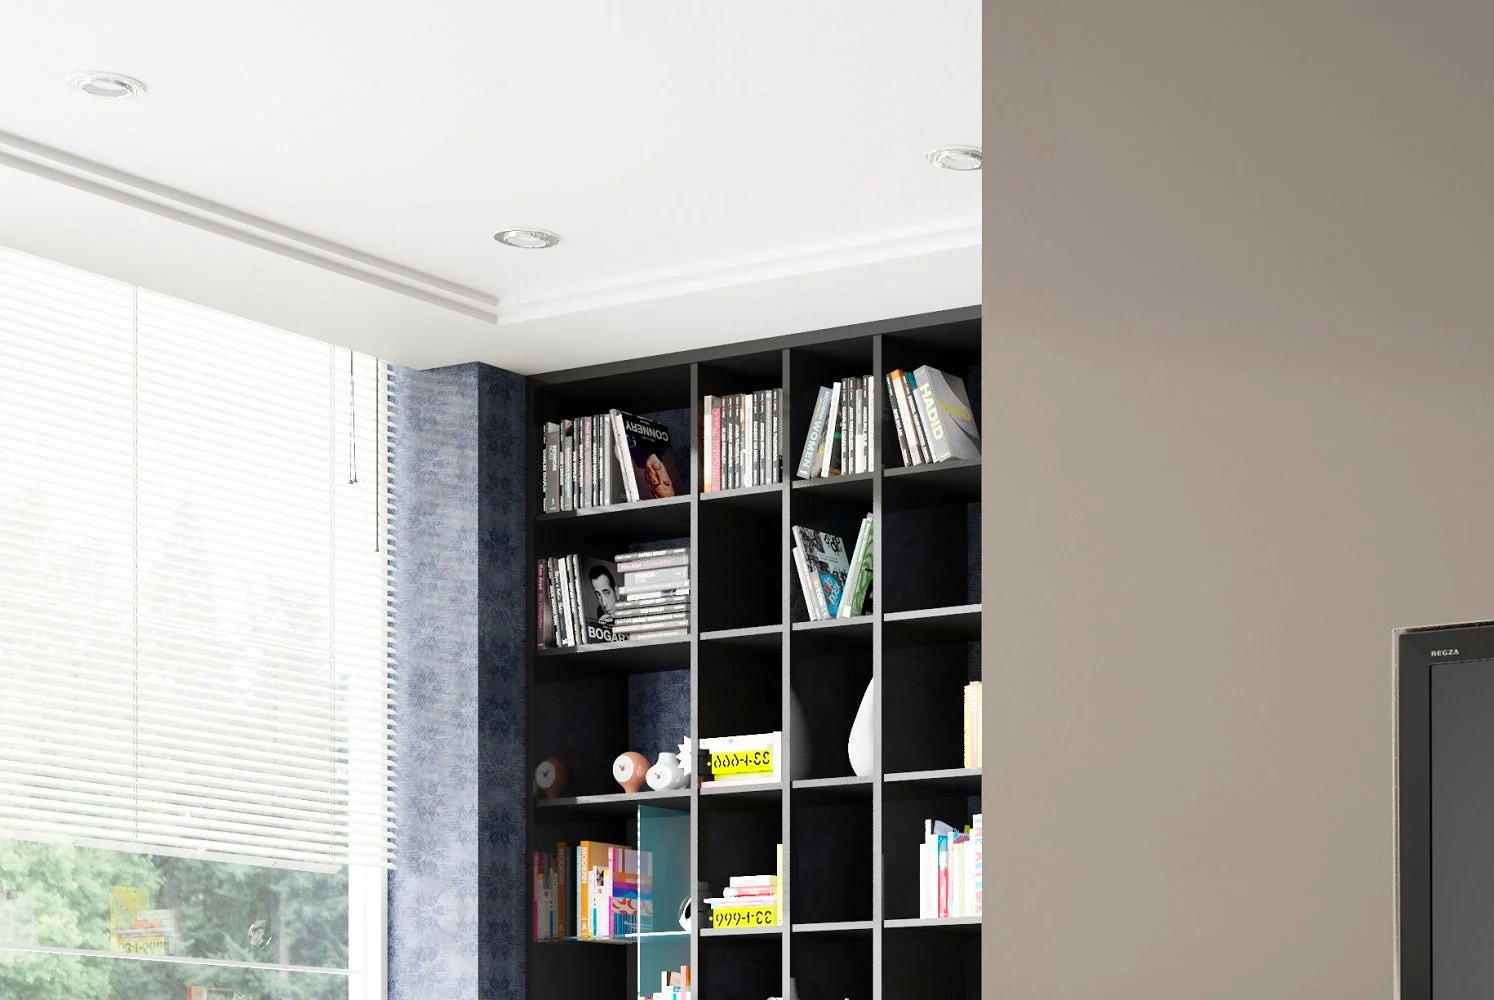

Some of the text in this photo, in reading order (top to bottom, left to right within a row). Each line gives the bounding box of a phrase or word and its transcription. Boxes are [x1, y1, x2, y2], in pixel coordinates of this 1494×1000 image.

[626, 420, 668, 441] CONNERY
[920, 382, 944, 440] HADID
[802, 421, 821, 468] WOMEN
